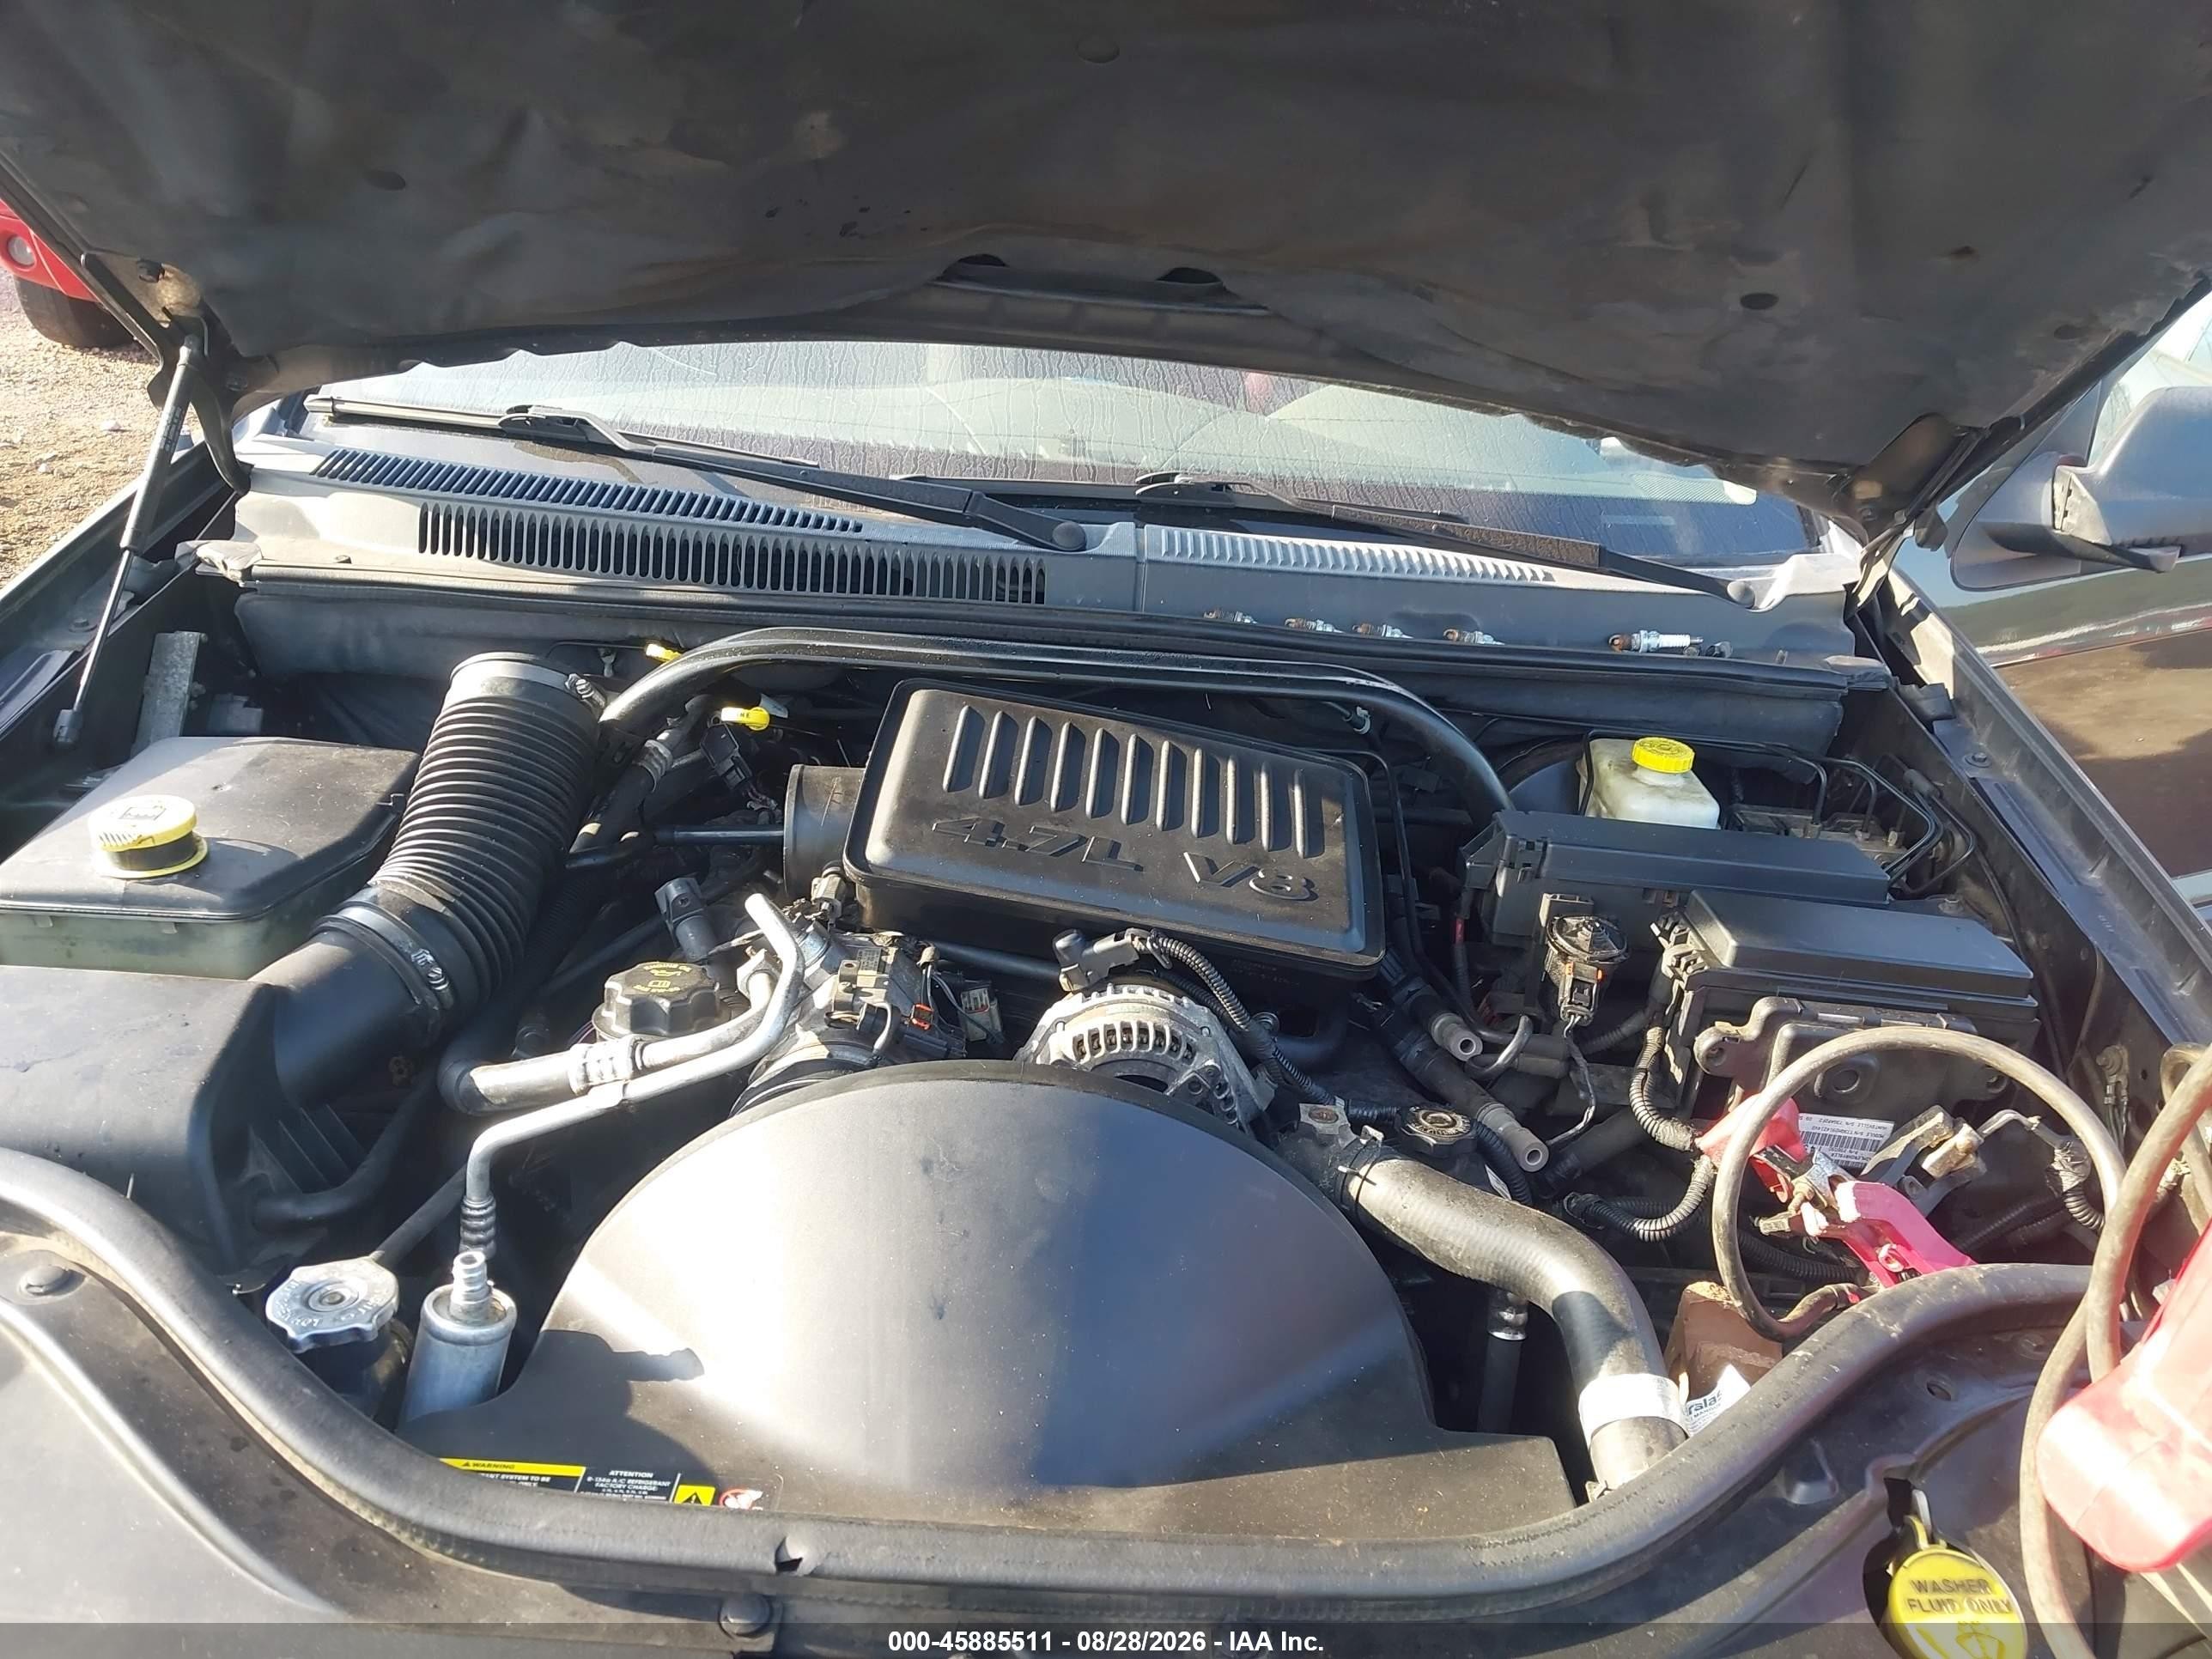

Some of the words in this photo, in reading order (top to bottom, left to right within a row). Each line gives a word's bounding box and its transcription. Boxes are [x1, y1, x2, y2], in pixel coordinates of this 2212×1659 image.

[932, 817, 1144, 872] 4.7L
[1183, 851, 1320, 902] V8
[627, 1479, 671, 1487] REFRIGERANT
[1910, 1578, 1992, 1595] WASHER
[1907, 1598, 1958, 1614] FLUID
[1962, 1597, 2014, 1614] ONLY
